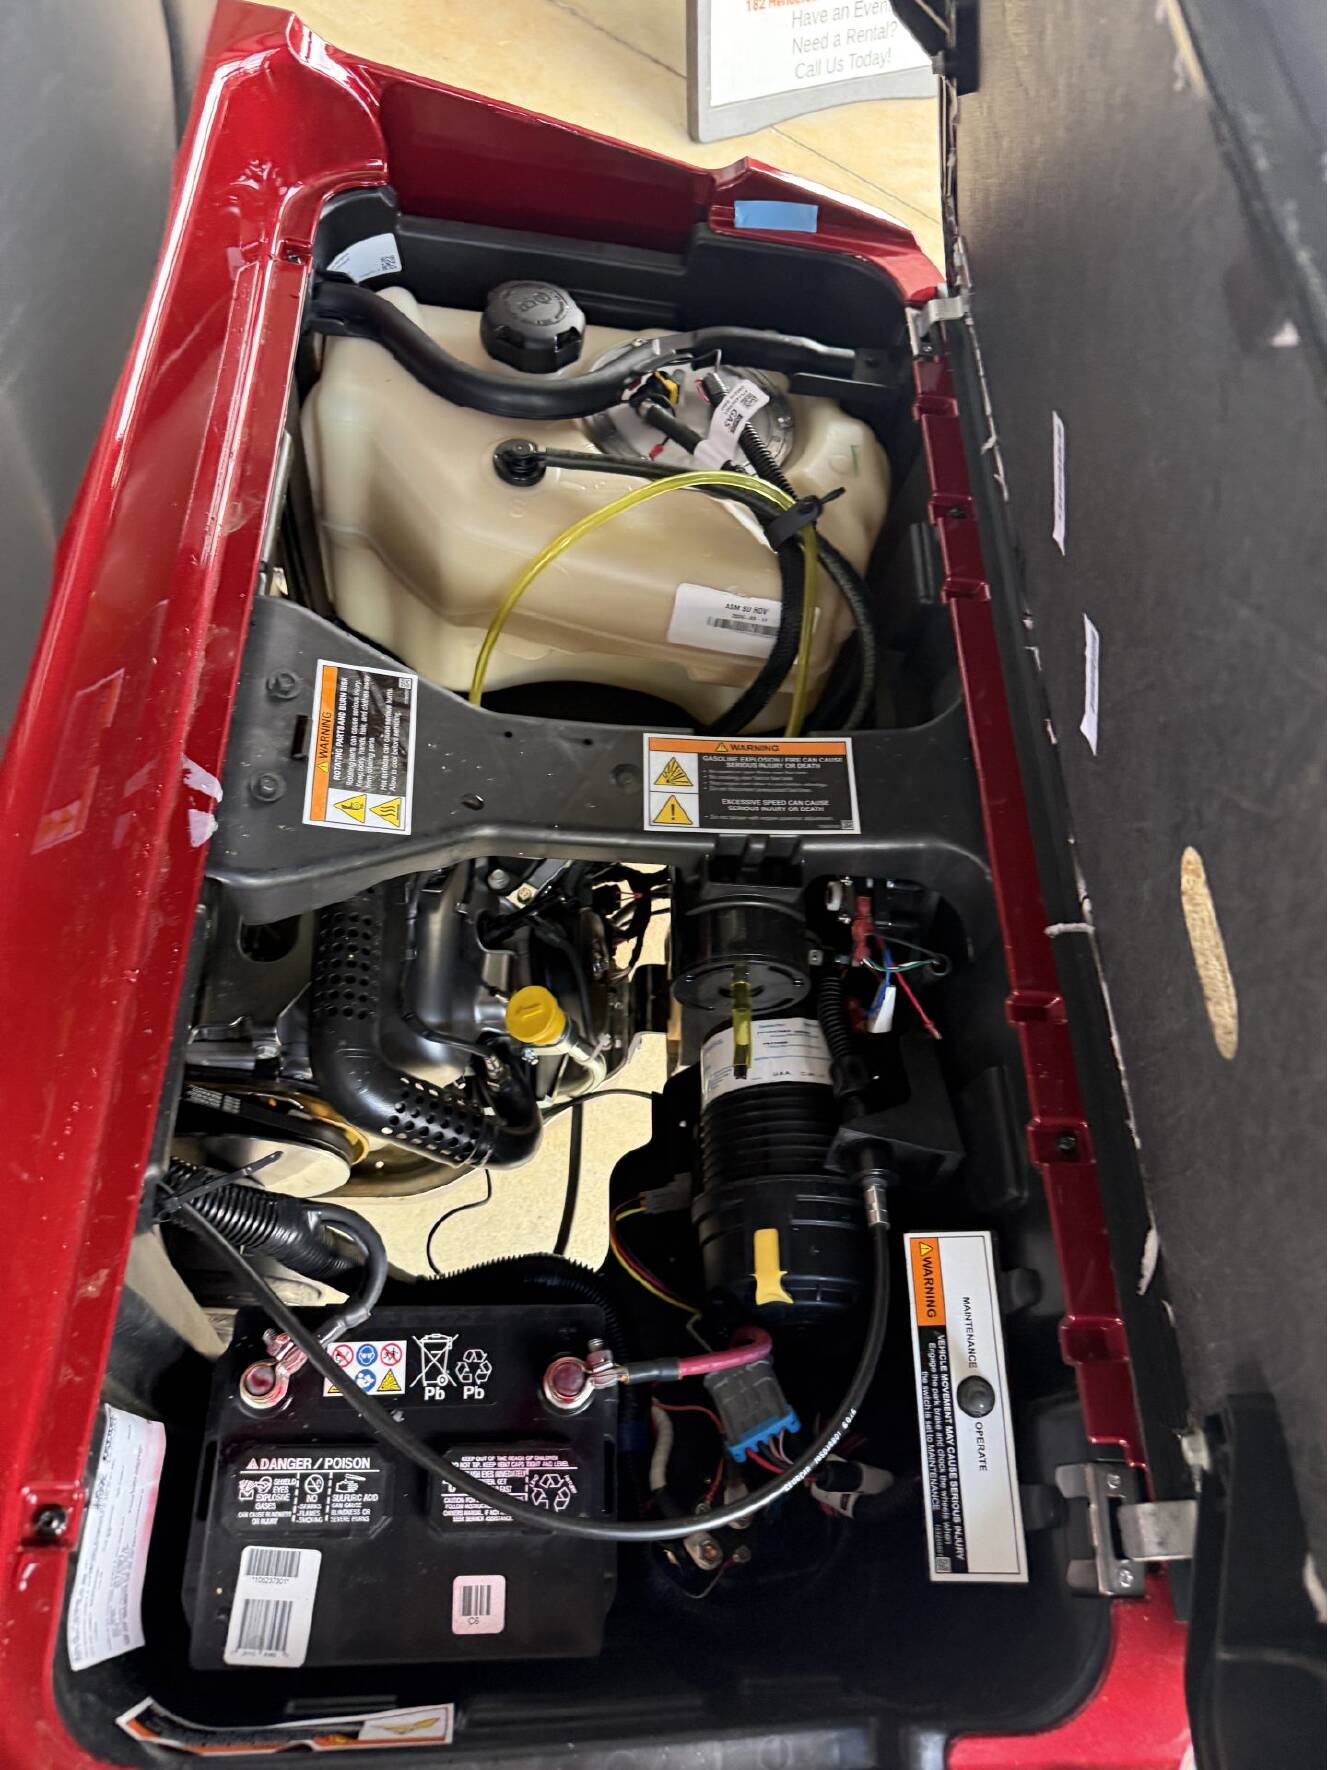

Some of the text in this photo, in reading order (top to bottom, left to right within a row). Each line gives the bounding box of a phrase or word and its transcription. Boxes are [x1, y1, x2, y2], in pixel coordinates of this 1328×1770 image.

[792, 9, 828, 29] Have
[833, 5, 849, 21] an
[792, 21, 898, 54] Need a Rental?
[795, 48, 891, 79] Call Us Today!
[337, 712, 346, 724] AND
[318, 712, 331, 758] WARNING
[730, 744, 780, 752] WARNING
[334, 749, 344, 780] ROTATING
[922, 1257, 936, 1317] WARNING
[962, 1297, 978, 1368] MAINTENANCE
[928, 1342, 938, 1372] Engage
[424, 1386, 446, 1400] Pb
[463, 1386, 485, 1399] Pb
[922, 1386, 932, 1409] switch
[930, 1388, 942, 1406] park
[926, 1421, 934, 1432] set
[934, 1408, 943, 1429] brake
[936, 1432, 945, 1446] and
[937, 1335, 964, 1560] VEHICLE MOVEMENT MAY CAUSE SERIOUS INJURY
[975, 1422, 987, 1471] OPERATE
[260, 1458, 312, 1469] DANGER
[324, 1457, 370, 1469] POISON
[937, 1449, 947, 1472] chock
[928, 1445, 940, 1510] MAINTENANCE
[940, 1475, 948, 1488] the
[940, 1491, 950, 1518] wheels
[943, 1522, 952, 1544] when
